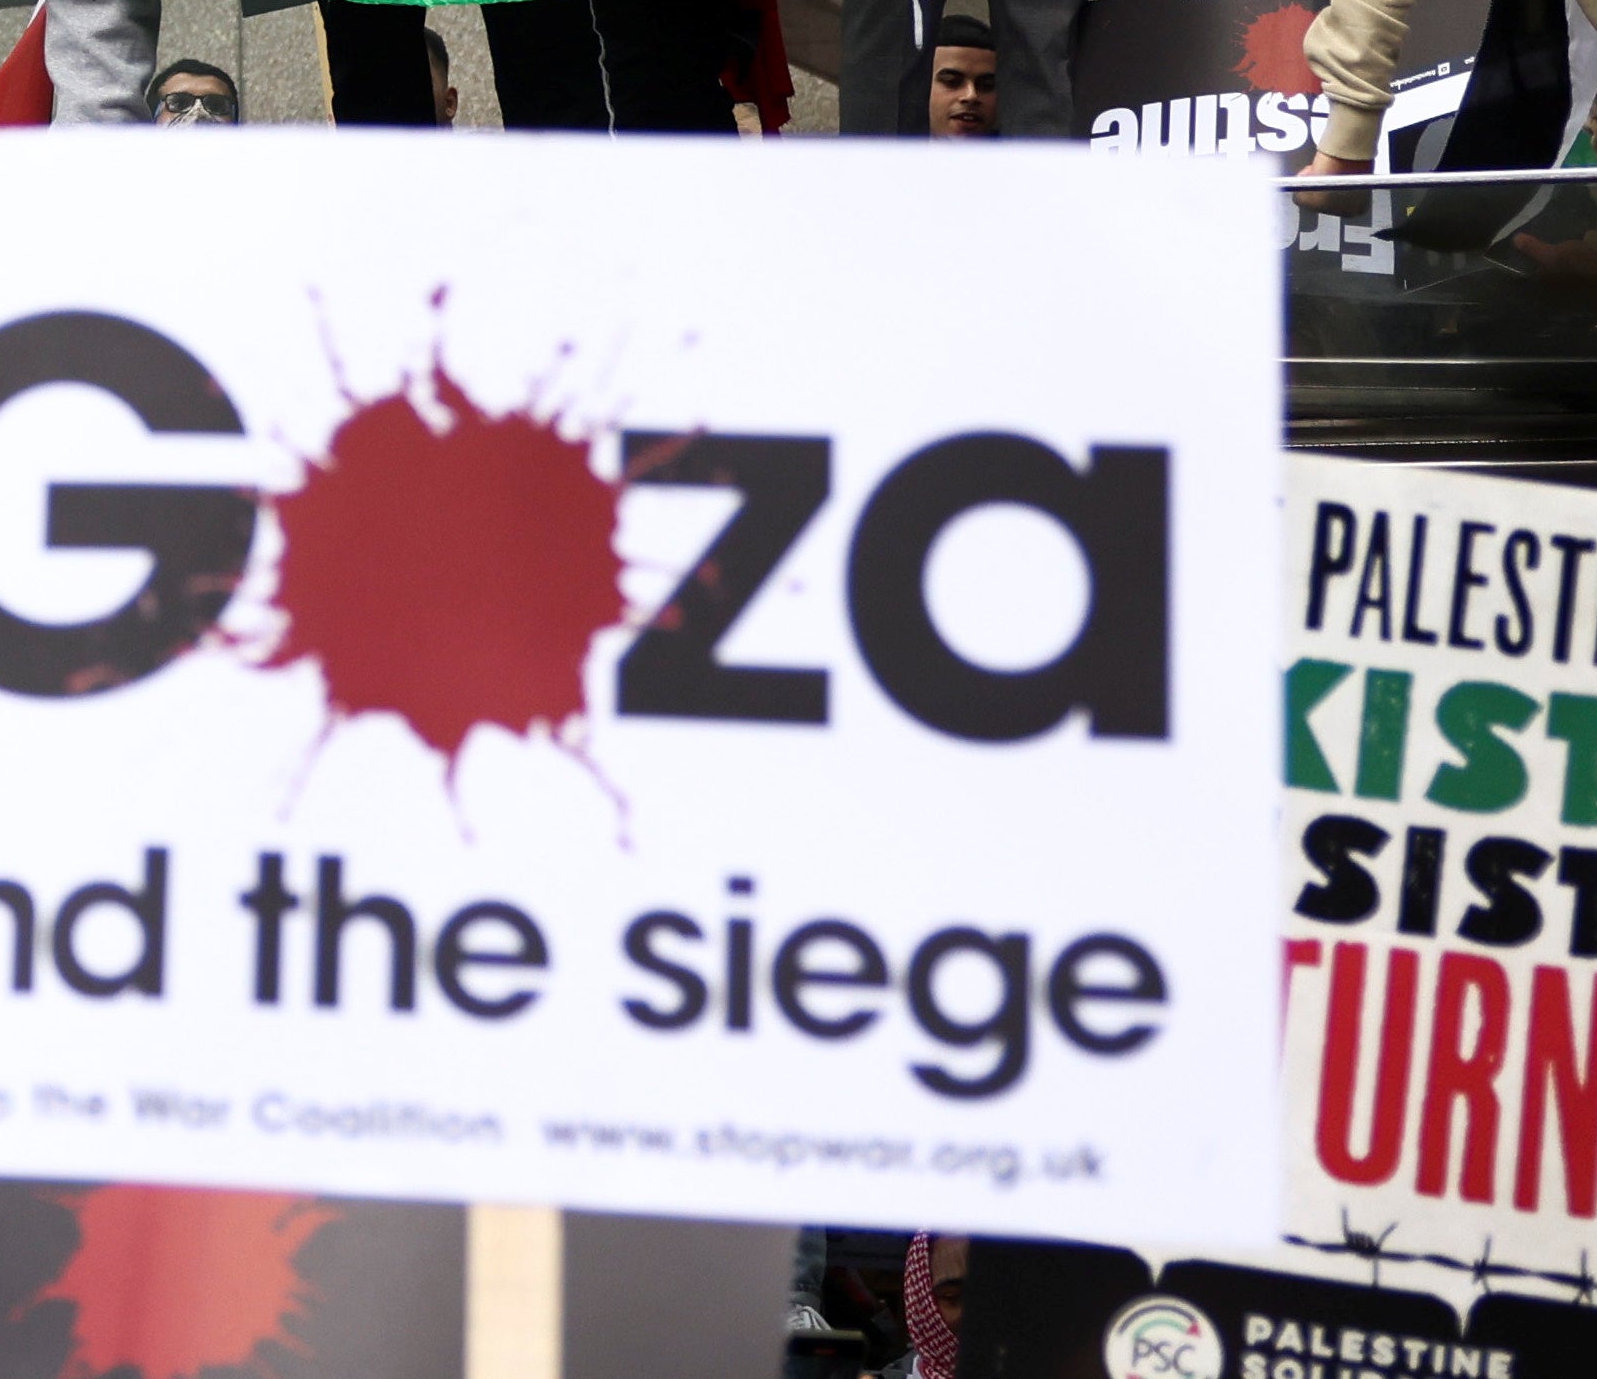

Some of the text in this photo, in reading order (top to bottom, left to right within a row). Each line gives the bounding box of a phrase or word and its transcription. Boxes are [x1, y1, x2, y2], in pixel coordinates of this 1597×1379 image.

[240, 851, 553, 1020] the
[618, 875, 1171, 1103] siege
[30, 1079, 110, 1126] the
[132, 1085, 231, 1132] War
[251, 1089, 506, 1149] Coalition
[539, 1112, 1108, 1190] www.stopwar.org.uk
[1131, 1340, 1196, 1377] PSC
[1243, 1311, 1514, 1379] PALESTINE
